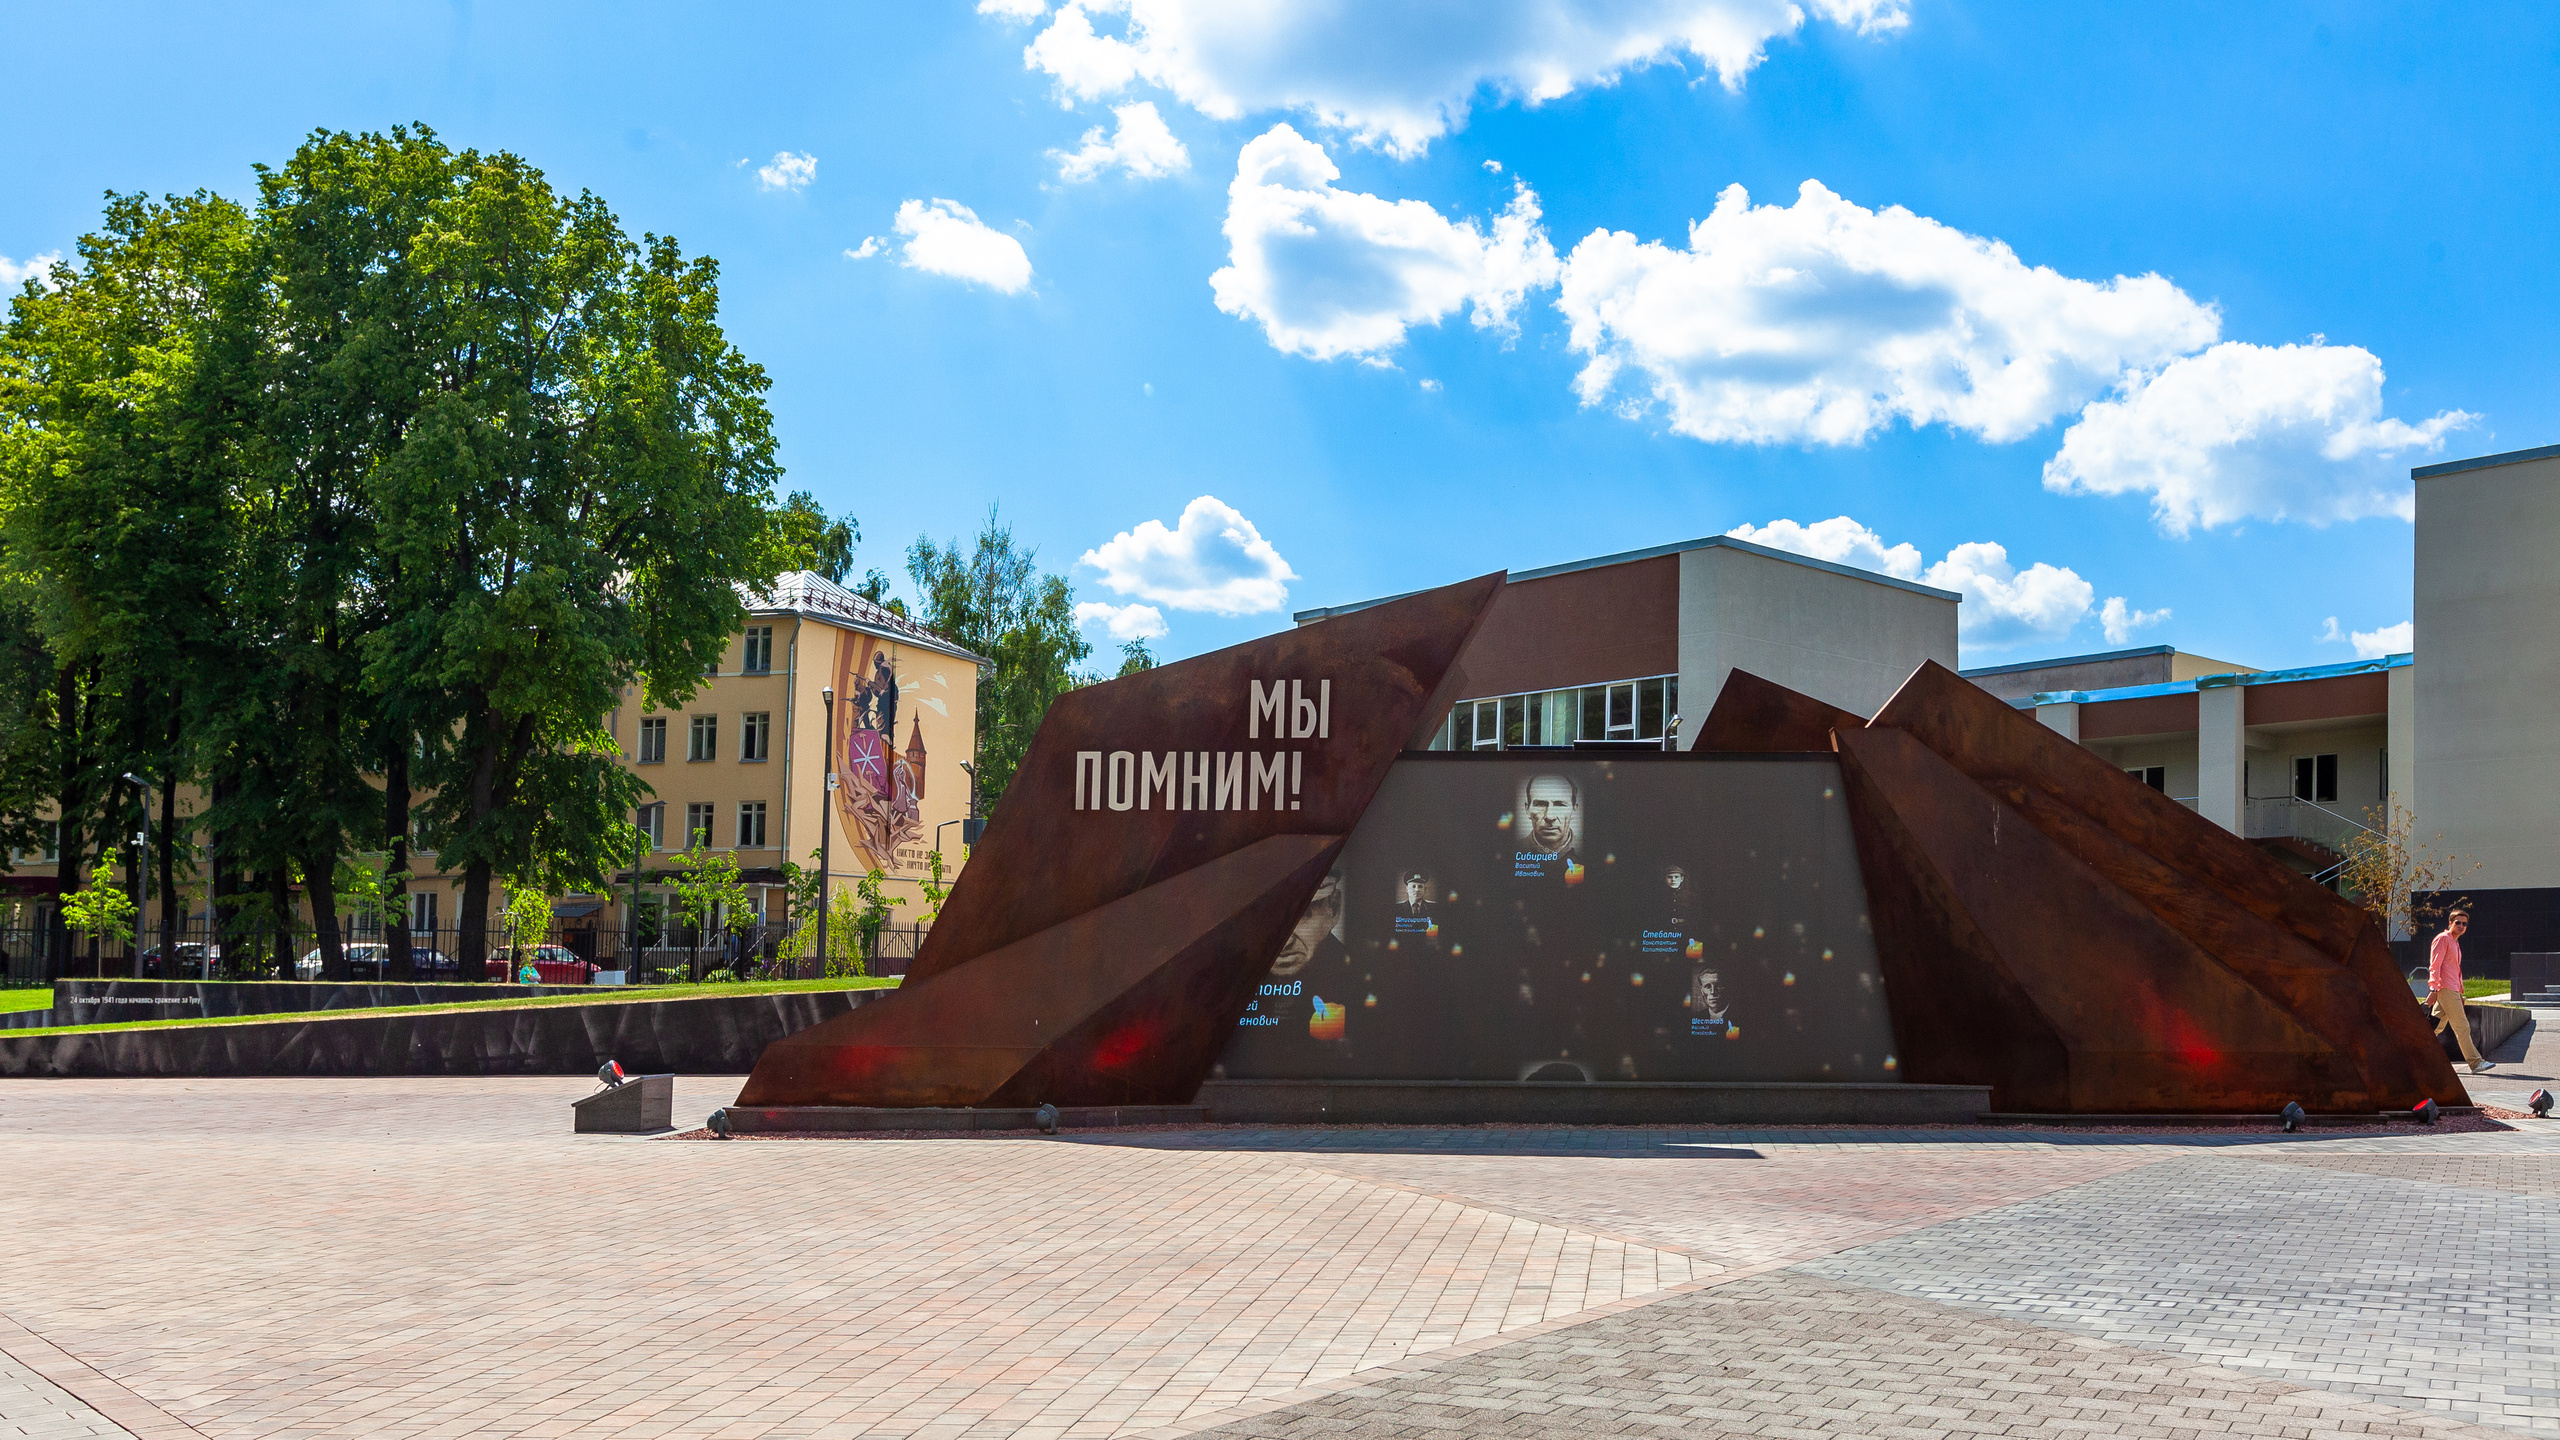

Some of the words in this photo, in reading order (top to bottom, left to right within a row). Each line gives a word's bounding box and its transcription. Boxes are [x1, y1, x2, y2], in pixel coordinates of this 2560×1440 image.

[1250, 680, 1330, 738] МЫ
[1075, 751, 1302, 811] ПОМНИМ!
[896, 848, 915, 858] НИКТО
[1515, 851, 1558, 862] Сибирцев
[1642, 930, 1682, 938] Стебалин
[70, 996, 78, 1004] 24
[78, 996, 101, 1005] октября
[101, 996, 114, 1004] 1941
[154, 997, 181, 1005] сражение
[1239, 1015, 1279, 1026] енович
